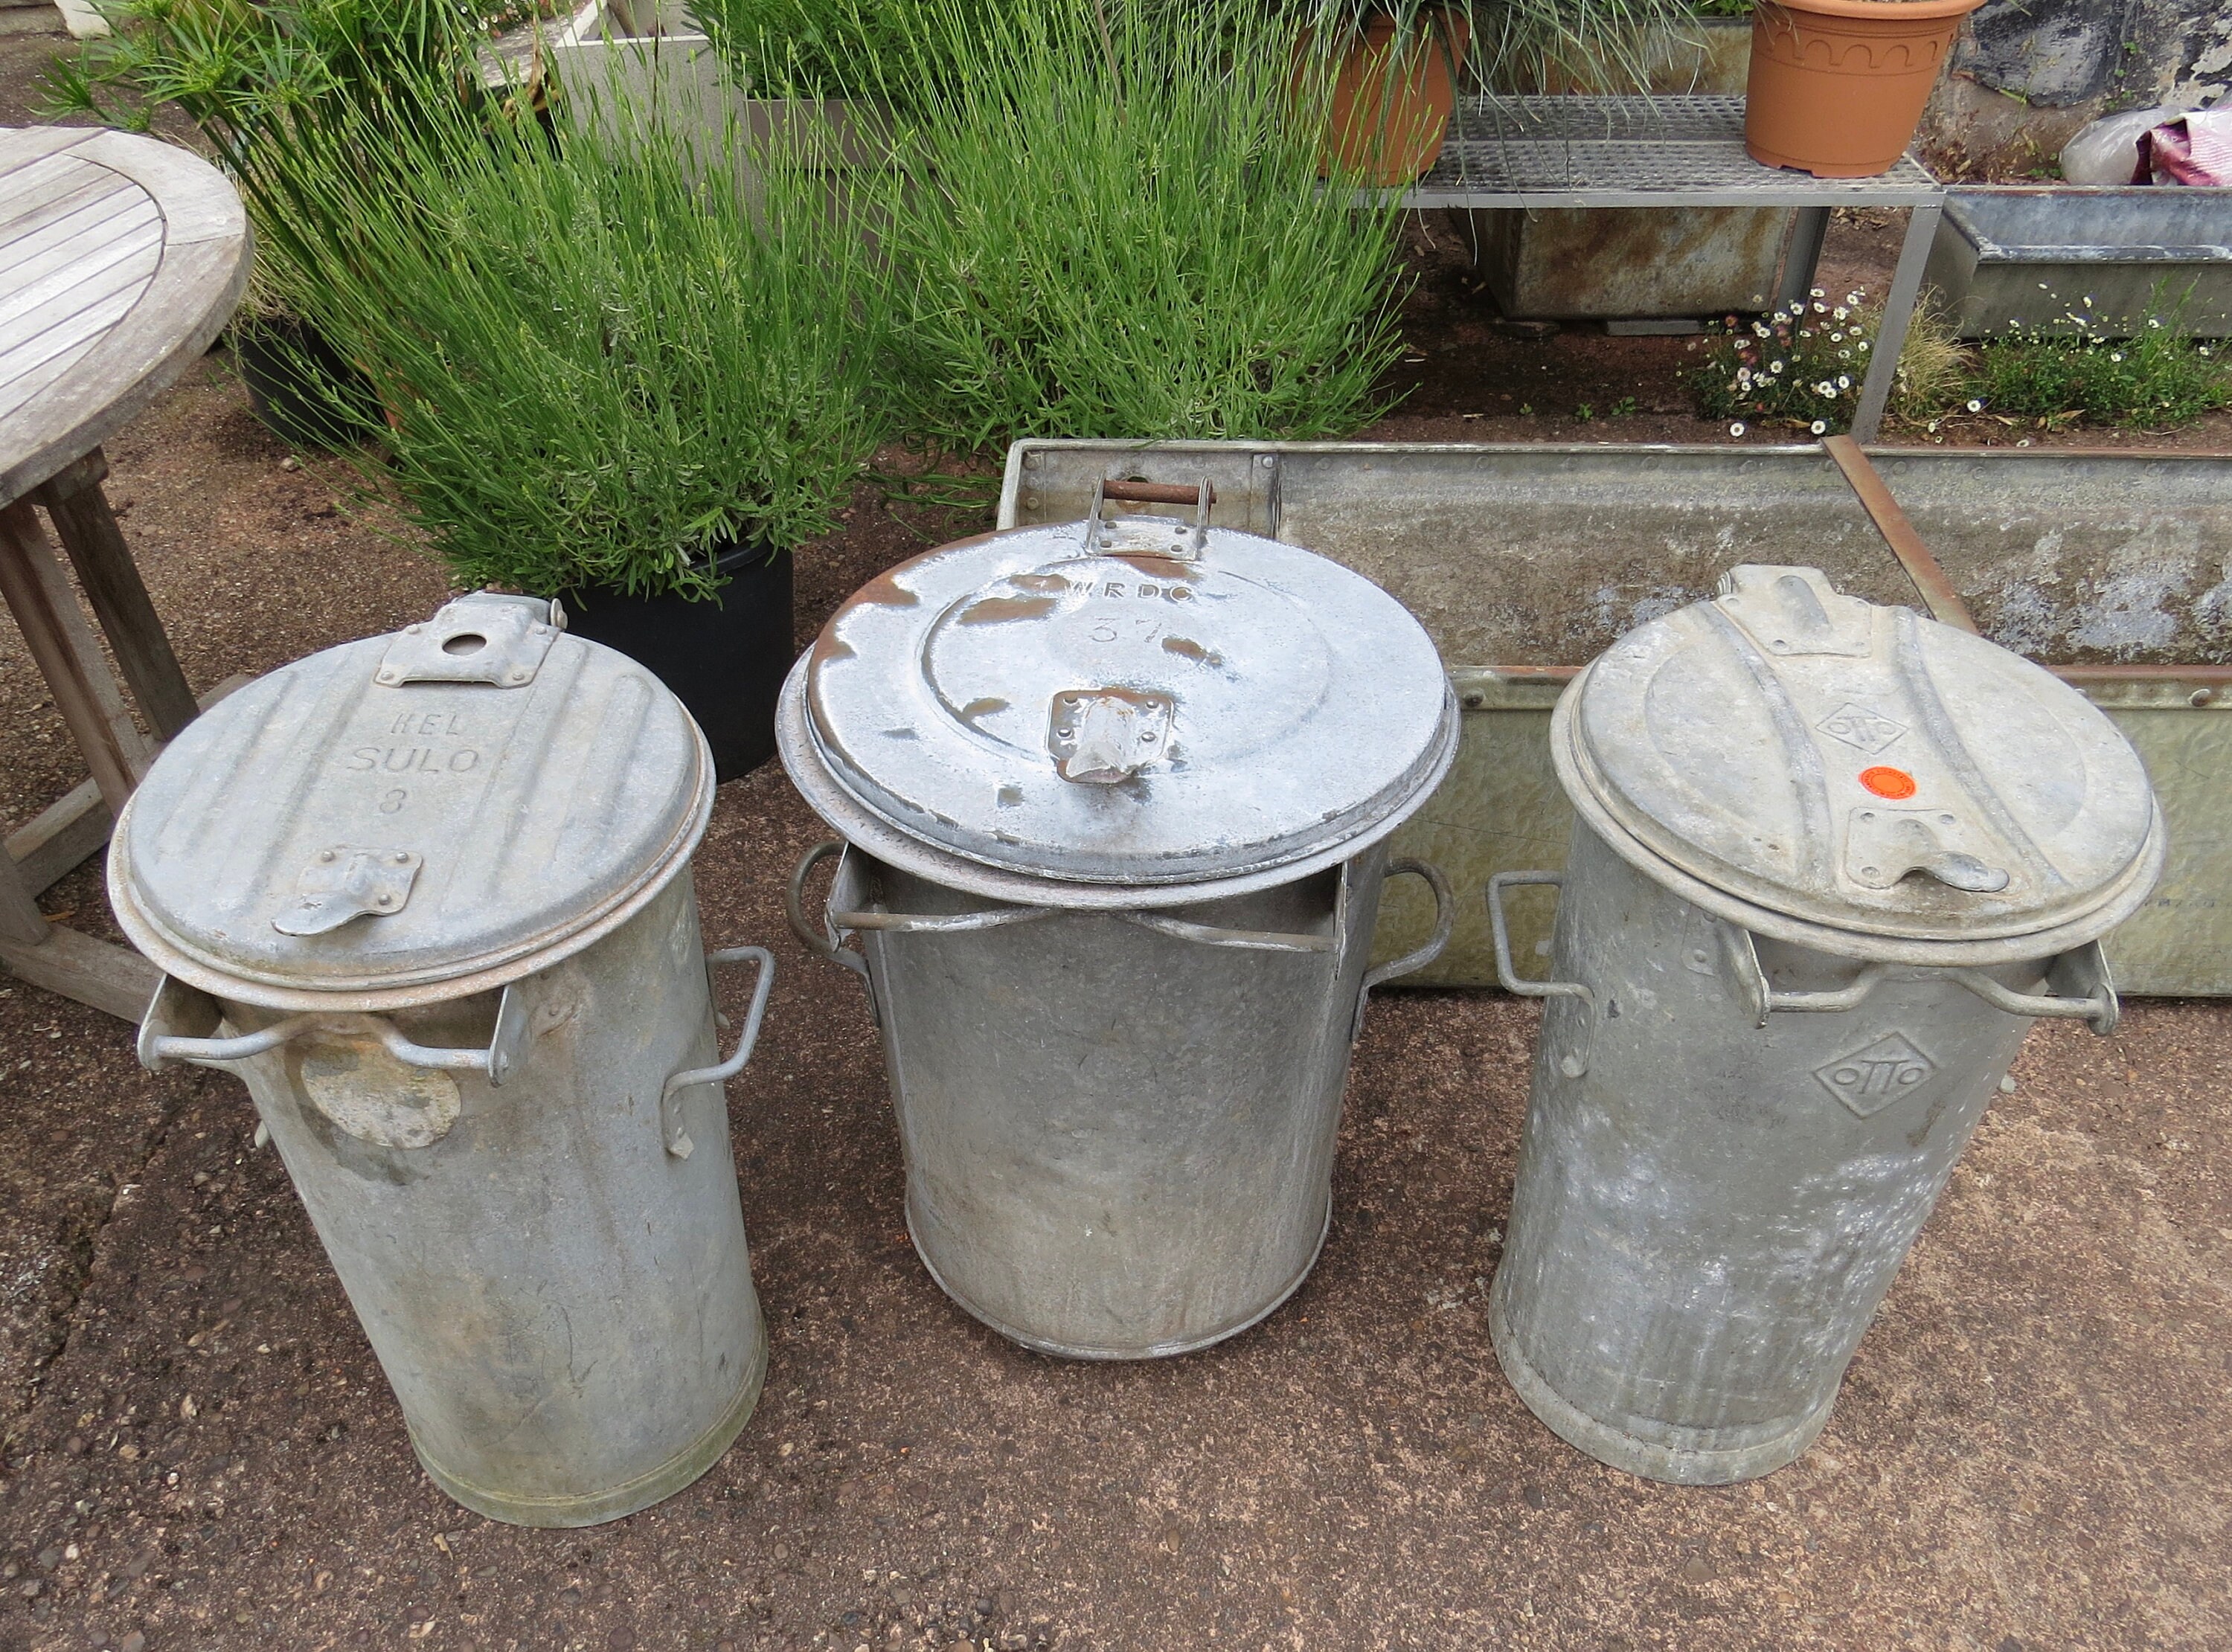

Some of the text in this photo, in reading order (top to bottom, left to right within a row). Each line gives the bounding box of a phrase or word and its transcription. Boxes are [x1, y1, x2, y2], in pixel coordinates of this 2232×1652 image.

[1827, 716, 1897, 742] OTTO
[346, 746, 479, 773] SULO
[379, 788, 407, 814] 8
[1833, 1058, 1925, 1094] OTTO
